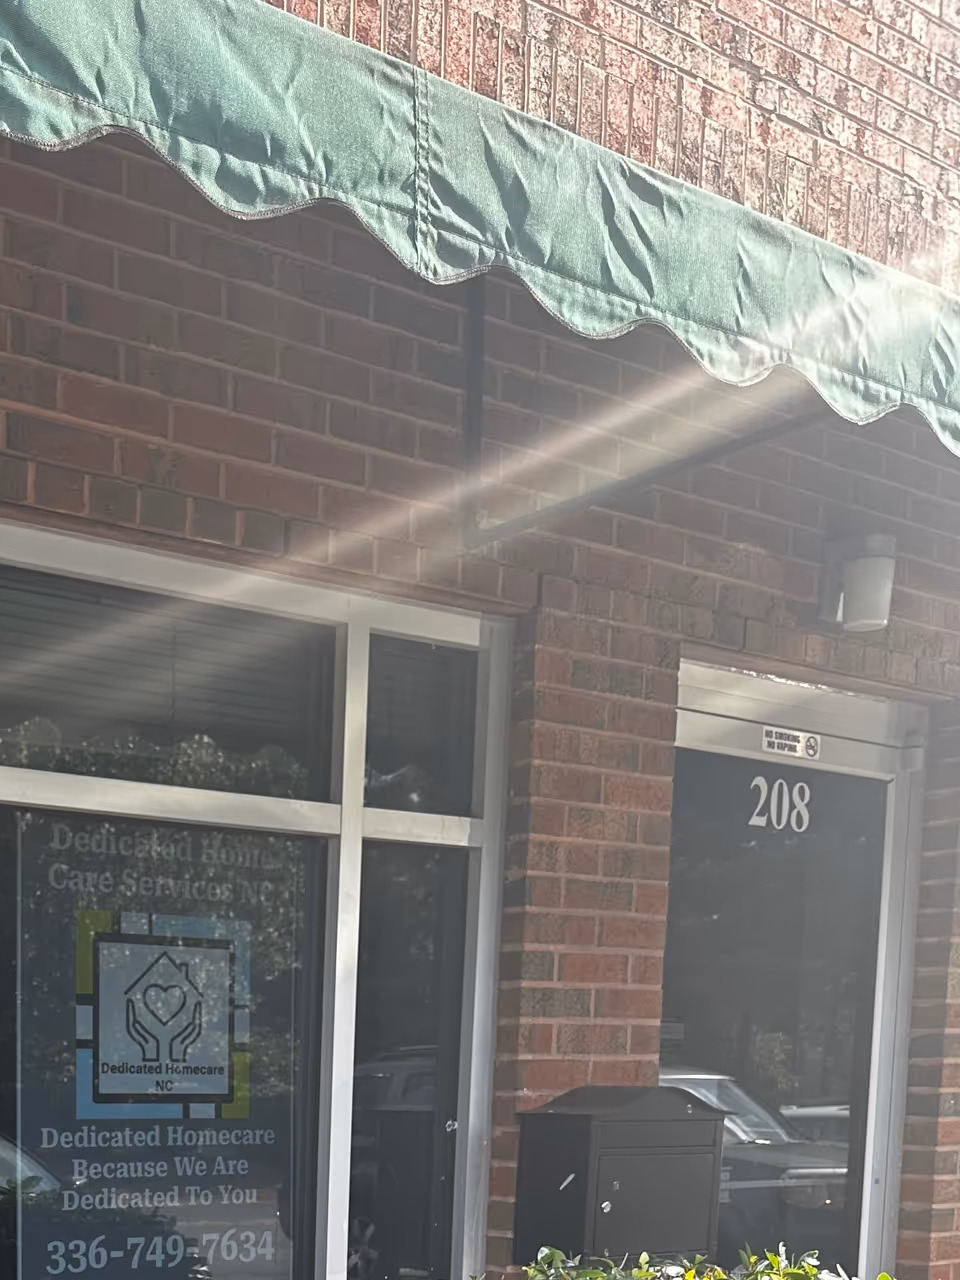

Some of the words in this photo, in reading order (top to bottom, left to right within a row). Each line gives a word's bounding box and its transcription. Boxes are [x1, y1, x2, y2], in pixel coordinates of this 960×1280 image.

[765, 730, 773, 738] NO
[775, 731, 800, 744] SMOKING
[767, 741, 775, 749] NO
[748, 776, 810, 832] 208
[49, 824, 192, 860] Dedicated
[48, 864, 114, 893] Care
[121, 870, 233, 902] Services
[101, 1063, 162, 1075] Dedicated
[165, 1064, 224, 1075] Homecare
[155, 1081, 173, 1092] NC
[40, 1125, 161, 1149] Dedicated
[167, 1126, 275, 1146] Homecare
[72, 1159, 168, 1179] Because
[174, 1157, 207, 1175] We
[212, 1156, 249, 1174] Are
[62, 1186, 180, 1211] Dedicated
[185, 1186, 213, 1205] To
[218, 1187, 258, 1204] You
[46, 1228, 275, 1274] 336-749-7634
